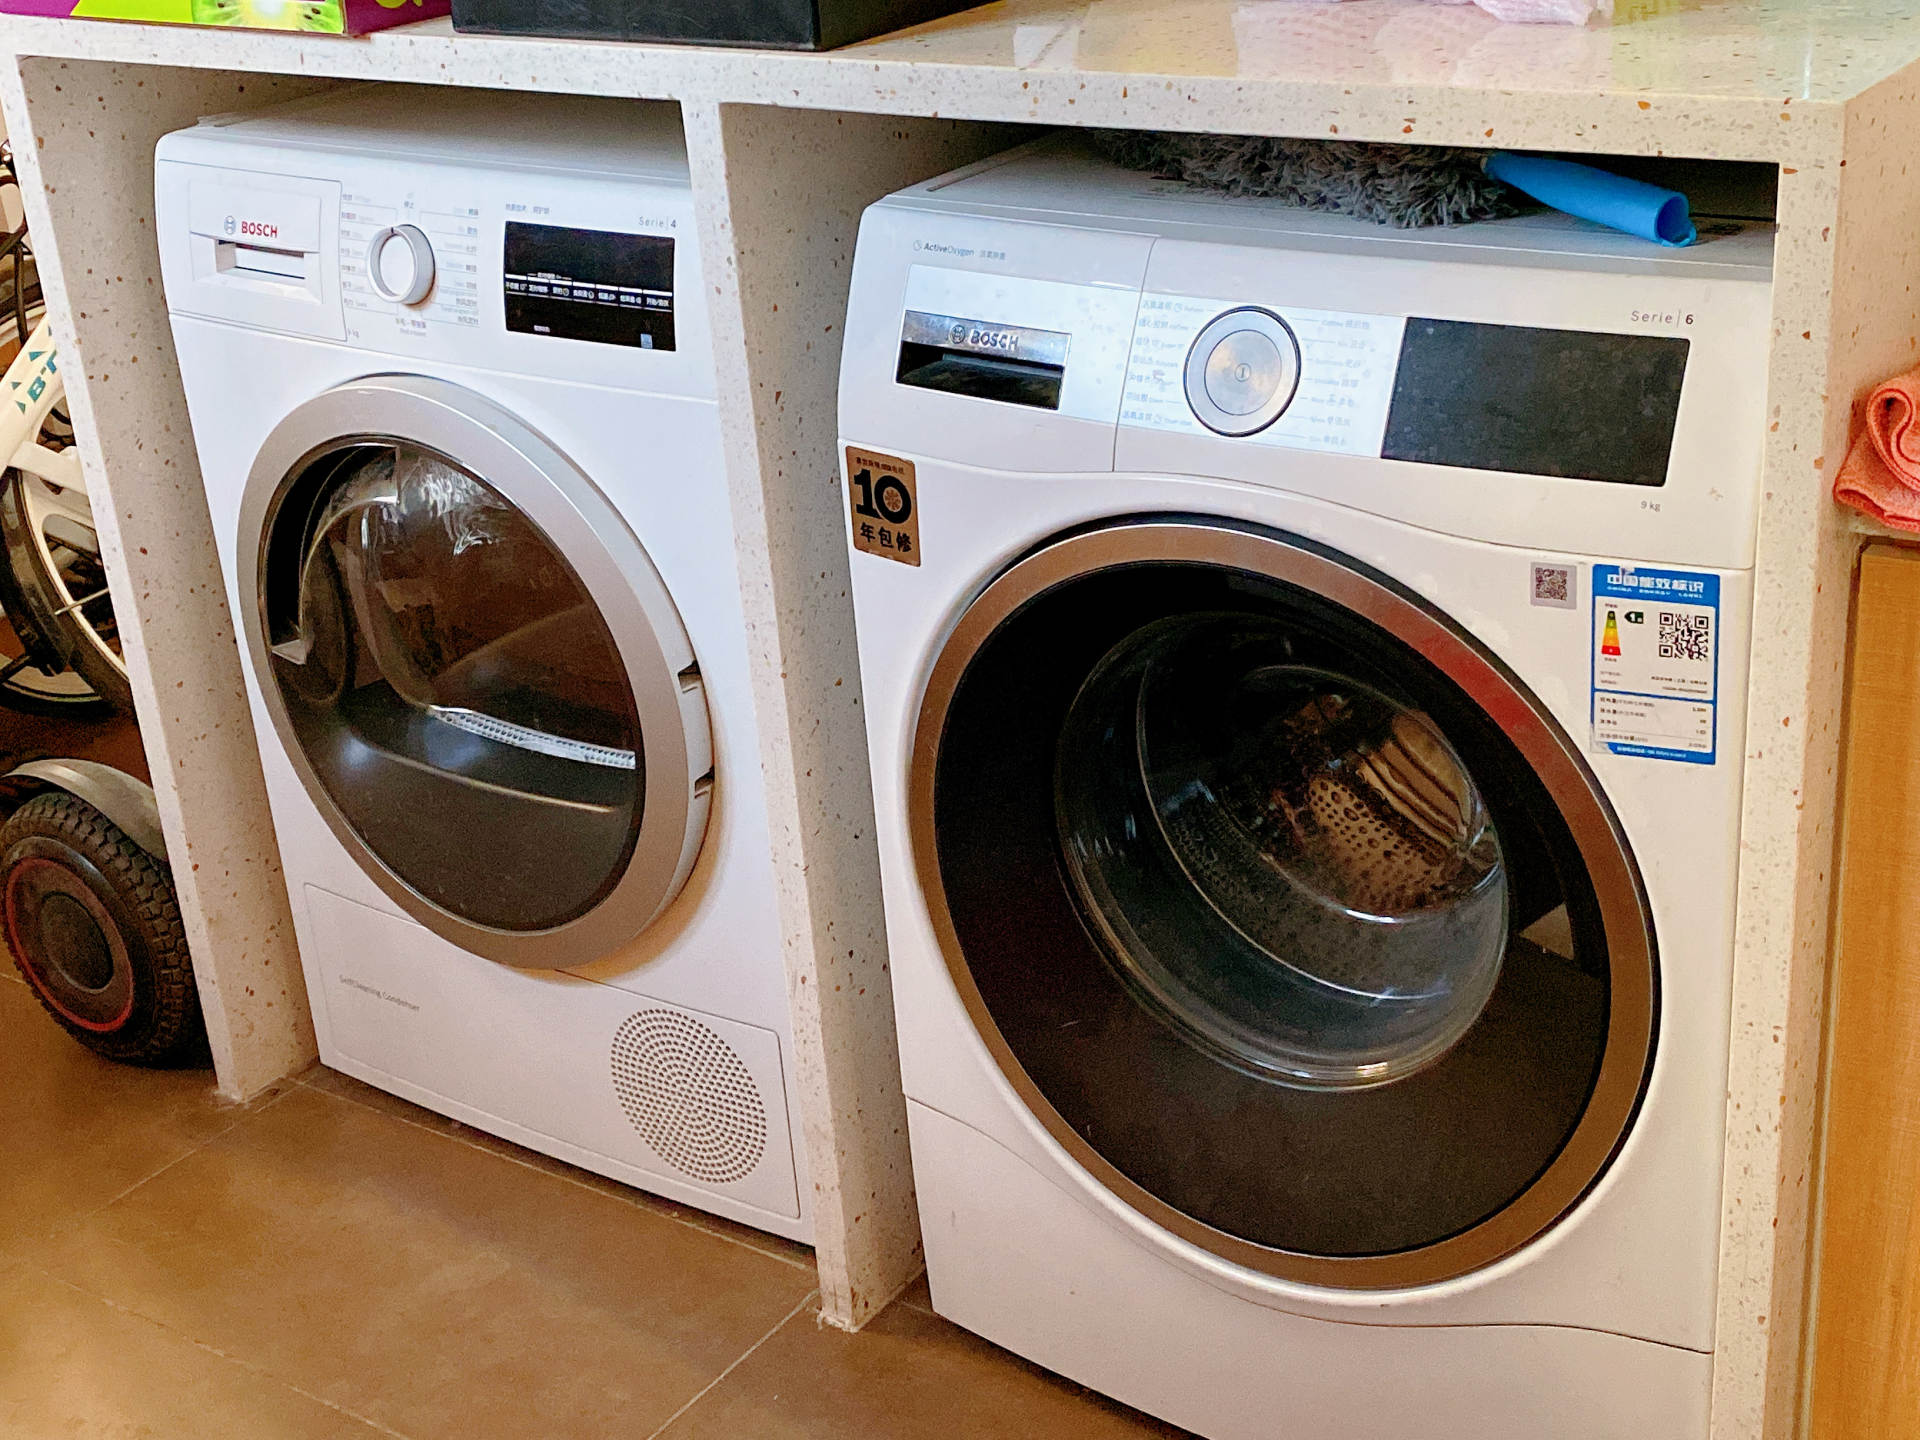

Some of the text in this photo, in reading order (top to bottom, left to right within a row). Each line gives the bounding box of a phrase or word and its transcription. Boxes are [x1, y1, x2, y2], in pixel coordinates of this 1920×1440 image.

[241, 220, 278, 239] BOSCH
[969, 328, 1020, 352] BOSCH
[853, 468, 912, 524] 10
[859, 521, 912, 553] 年包修
